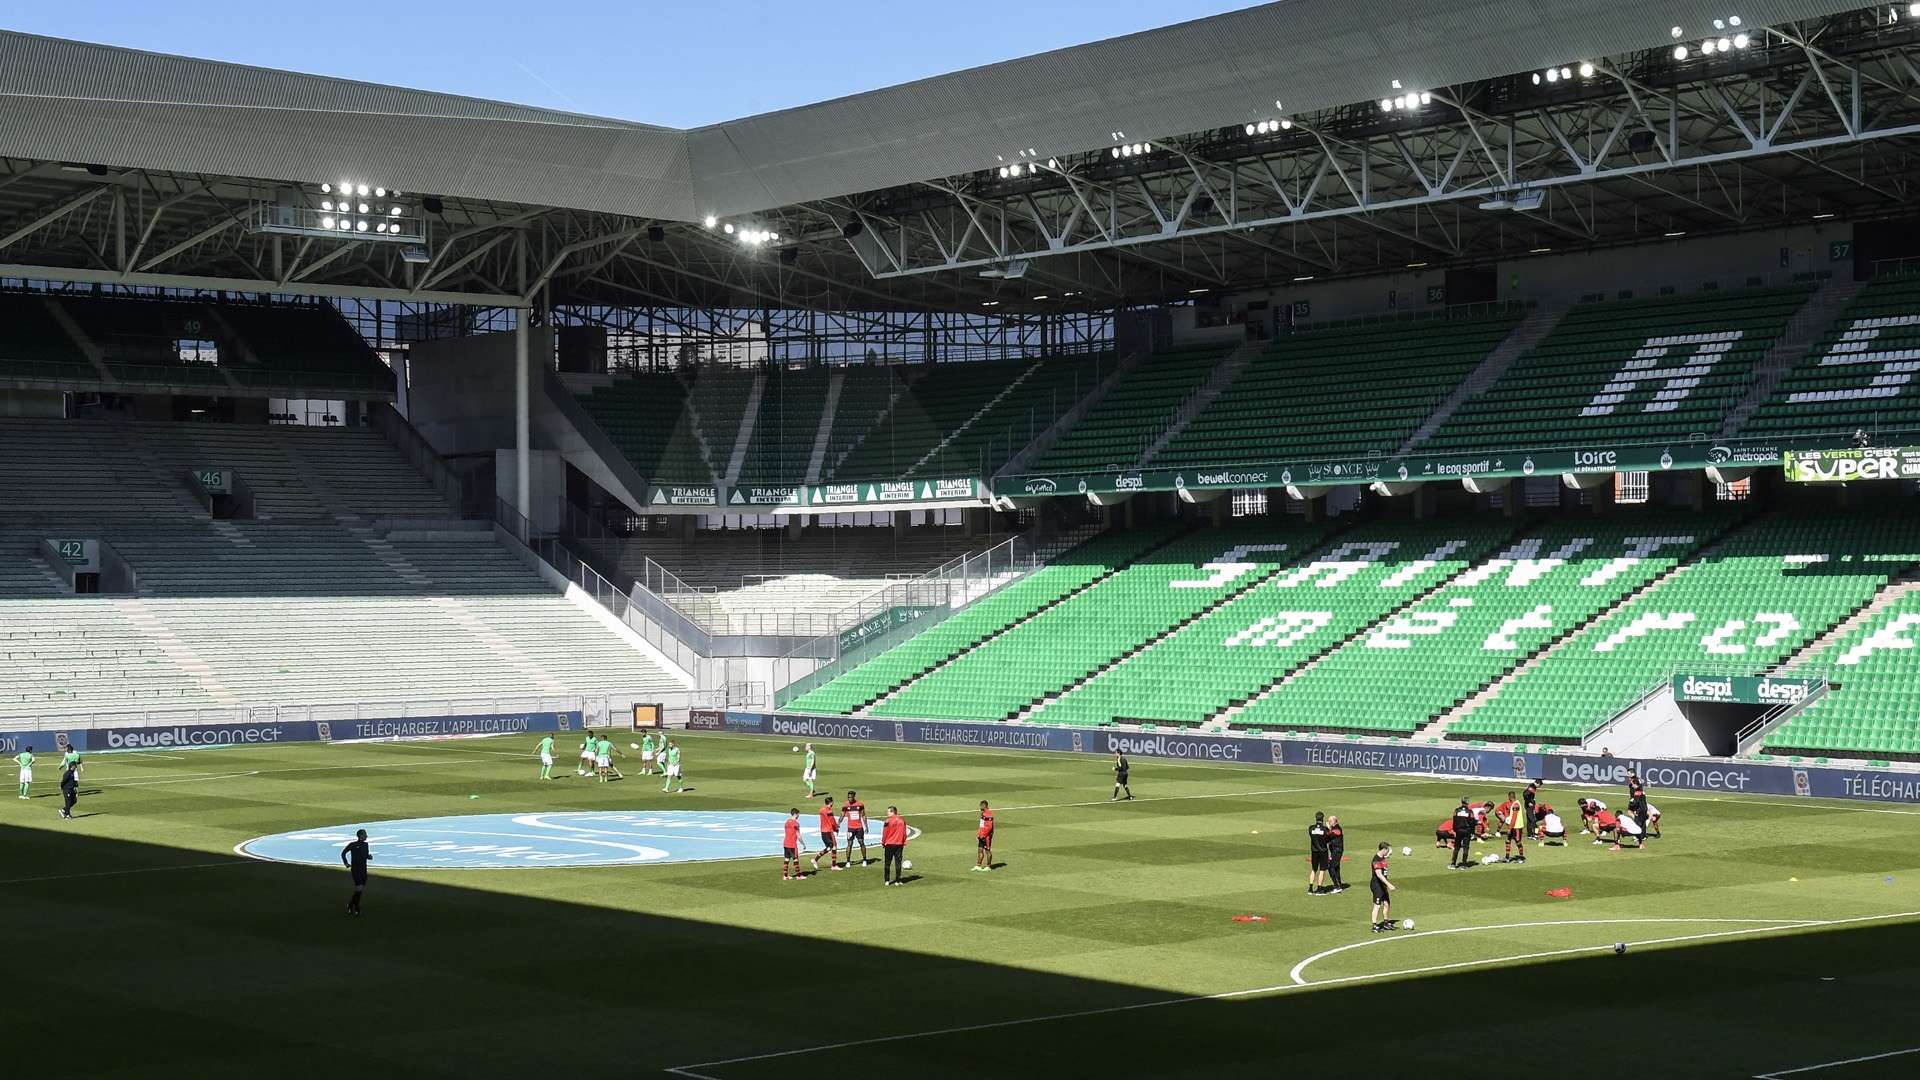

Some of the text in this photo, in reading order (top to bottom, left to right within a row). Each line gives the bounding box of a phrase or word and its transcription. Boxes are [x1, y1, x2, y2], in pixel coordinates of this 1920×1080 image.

[1832, 244, 1849, 258] 37
[1733, 452, 1779, 463] métropole
[1799, 448, 1900, 460] LES VERTS C'EST
[201, 472, 220, 486] 46
[936, 479, 971, 489] TRIANGLE
[1115, 473, 1143, 489] despi
[672, 487, 715, 497] TRIANGLE
[751, 487, 797, 496] TRIANGLE
[826, 484, 858, 494] TRIANGLE
[880, 482, 914, 491] TRIANGLE
[61, 543, 81, 557] 42
[1682, 675, 1733, 700] despi
[1757, 678, 1809, 702] despi
[356, 717, 528, 737] TÉLÉCHARGEZ L'APPLICATION
[692, 712, 720, 729] despi
[920, 724, 1048, 746] TÉLÉCHARGEZ L'APPLICATION
[1305, 745, 1480, 773] TÉLÉCHARGEZ L'APPLICATION
